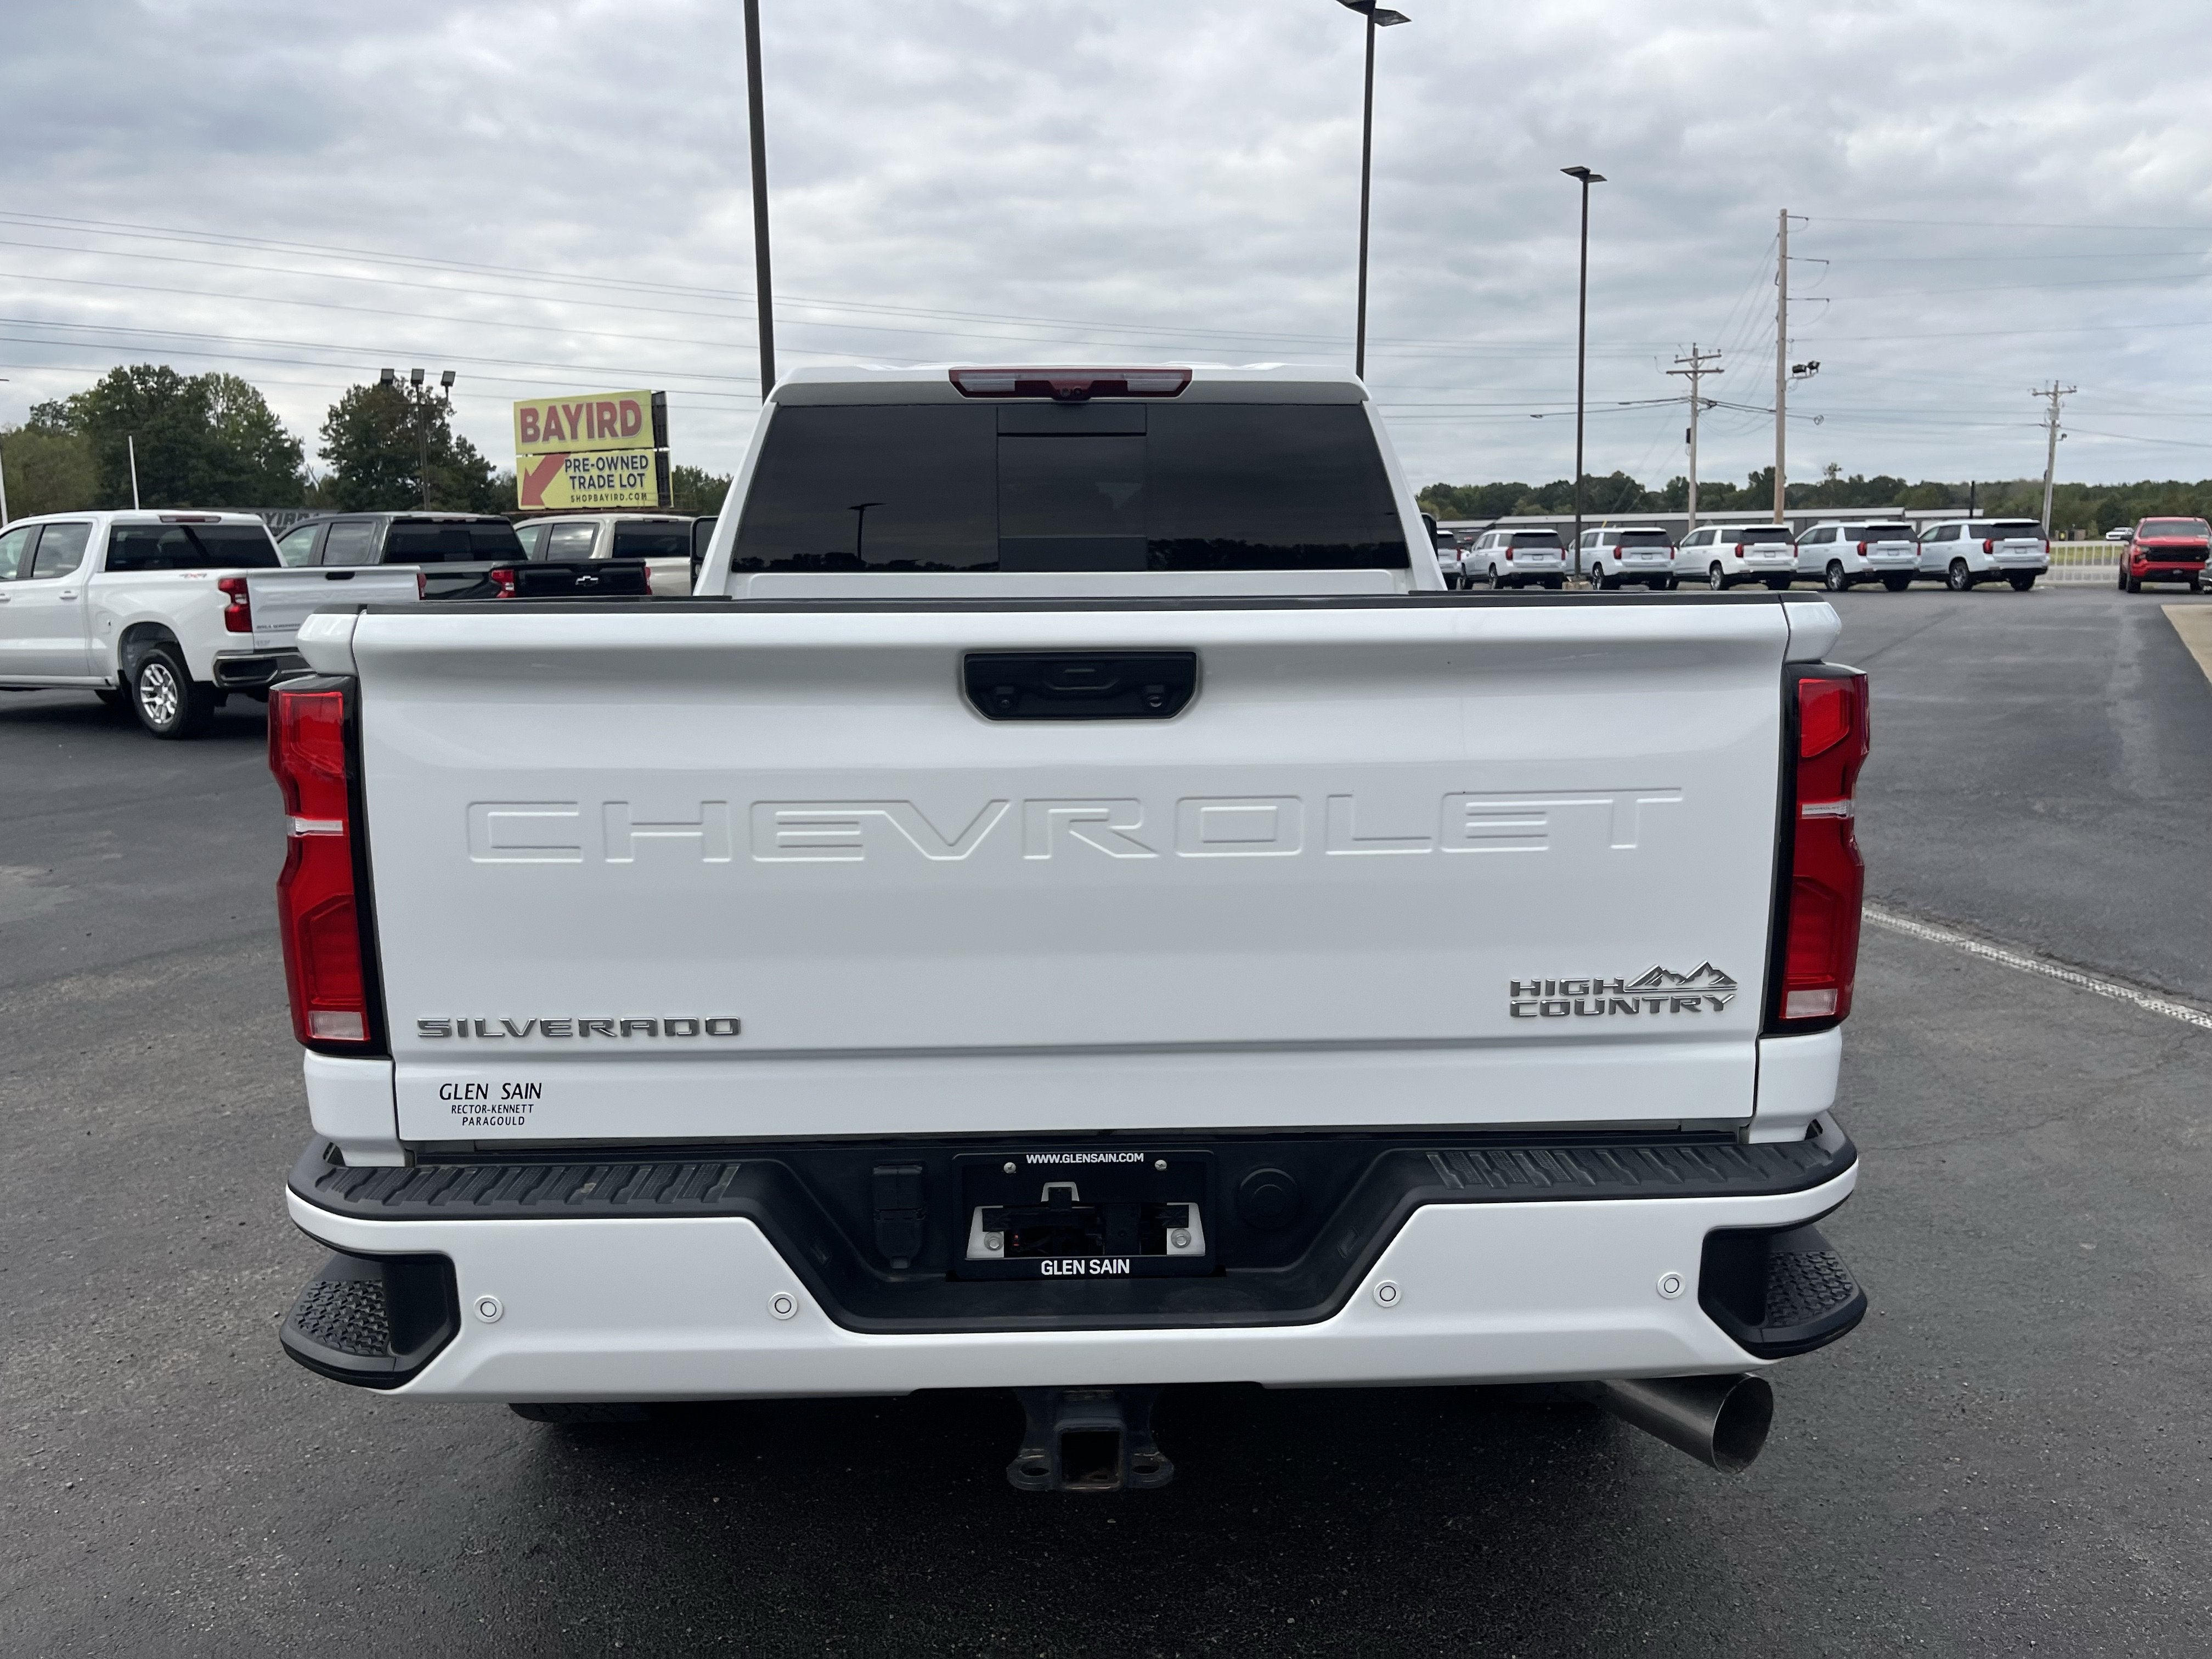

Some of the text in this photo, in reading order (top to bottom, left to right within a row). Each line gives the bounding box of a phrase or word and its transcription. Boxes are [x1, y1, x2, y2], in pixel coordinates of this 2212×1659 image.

[520, 399, 642, 444] BAYIRD
[565, 455, 648, 473] PRE-OWNED
[569, 473, 645, 490] TRADE LOT
[571, 493, 647, 503] SHOPBAYIRD.COM
[466, 787, 1683, 863] CHEVROLET
[1510, 977, 1625, 996] HIGH
[1510, 994, 1736, 1017] COUNTRY
[417, 1017, 742, 1038] SILVERADO
[439, 1082, 542, 1100] GLEN SAIN
[452, 1104, 534, 1114] RECTOR-KENNETT
[462, 1116, 525, 1126] PARAGOULD
[1026, 1153, 1144, 1164] WWW.GLENSAIN.COM
[1041, 1259, 1130, 1275] GLEN SAIN
